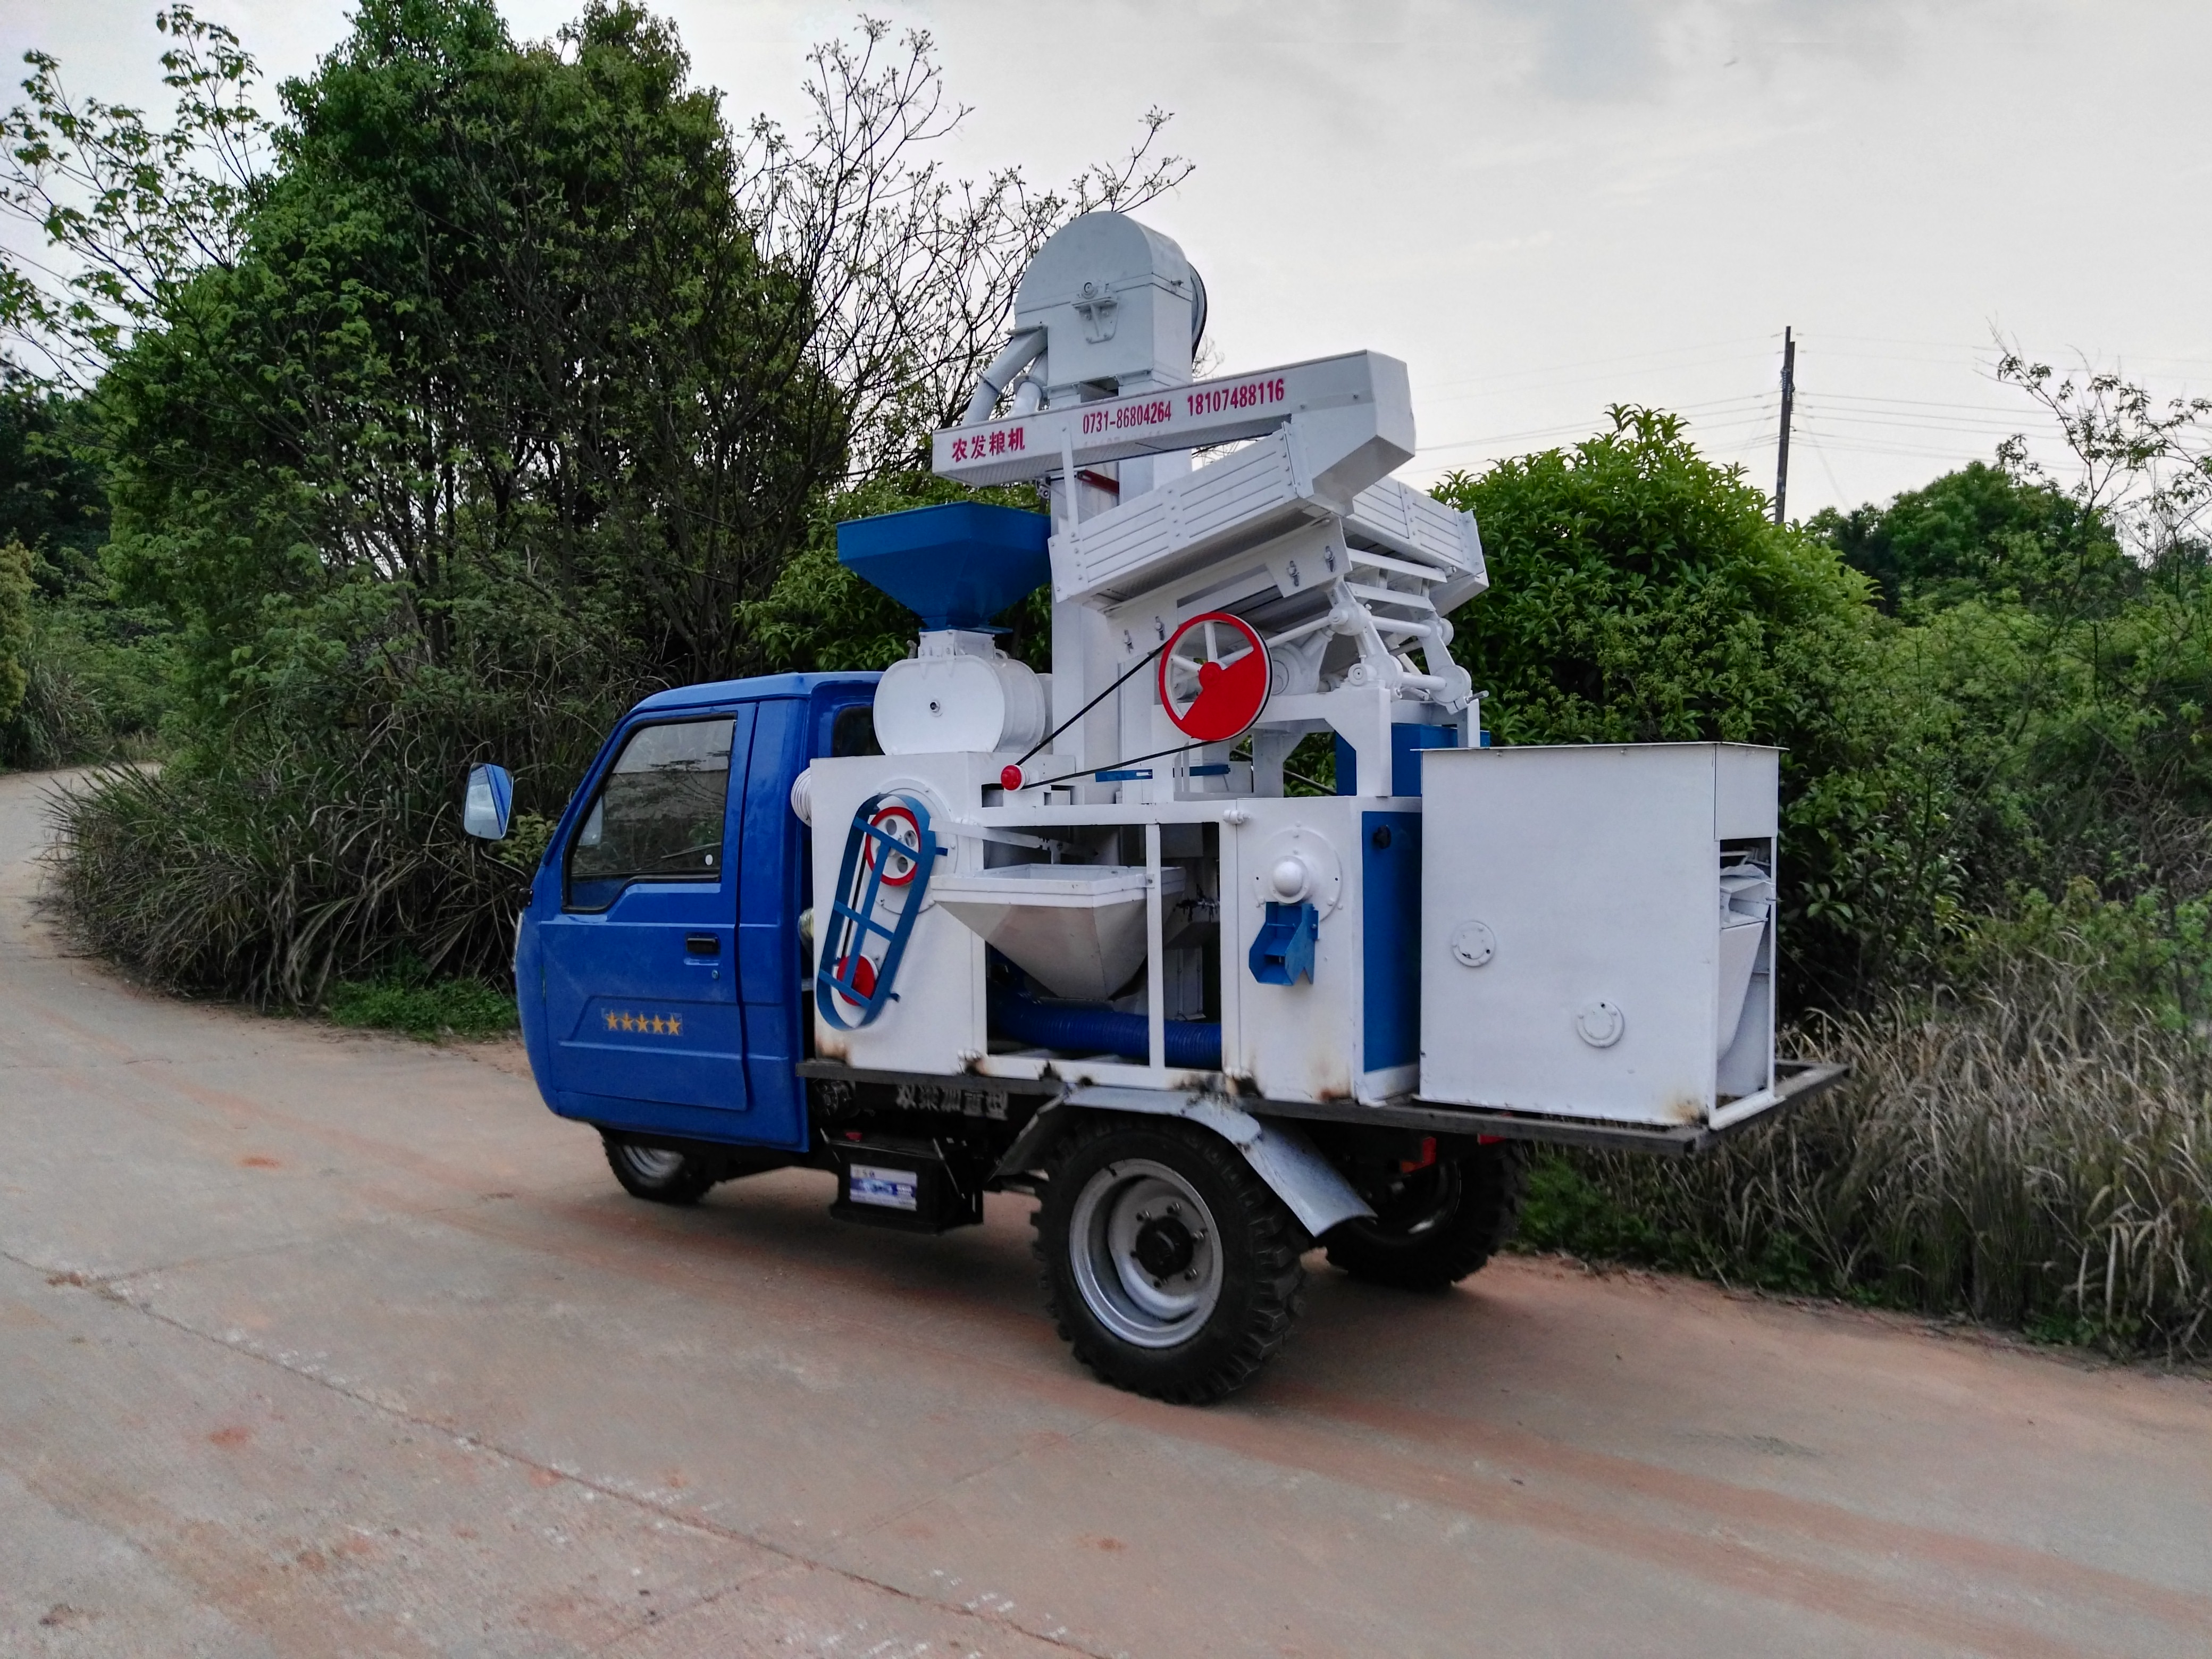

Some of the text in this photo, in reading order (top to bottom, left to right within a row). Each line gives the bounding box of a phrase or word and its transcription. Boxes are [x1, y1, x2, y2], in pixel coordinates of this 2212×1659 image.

[1083, 378, 1284, 434] 0731-86804264 18107488116
[952, 428, 1025, 463] 农发粮机
